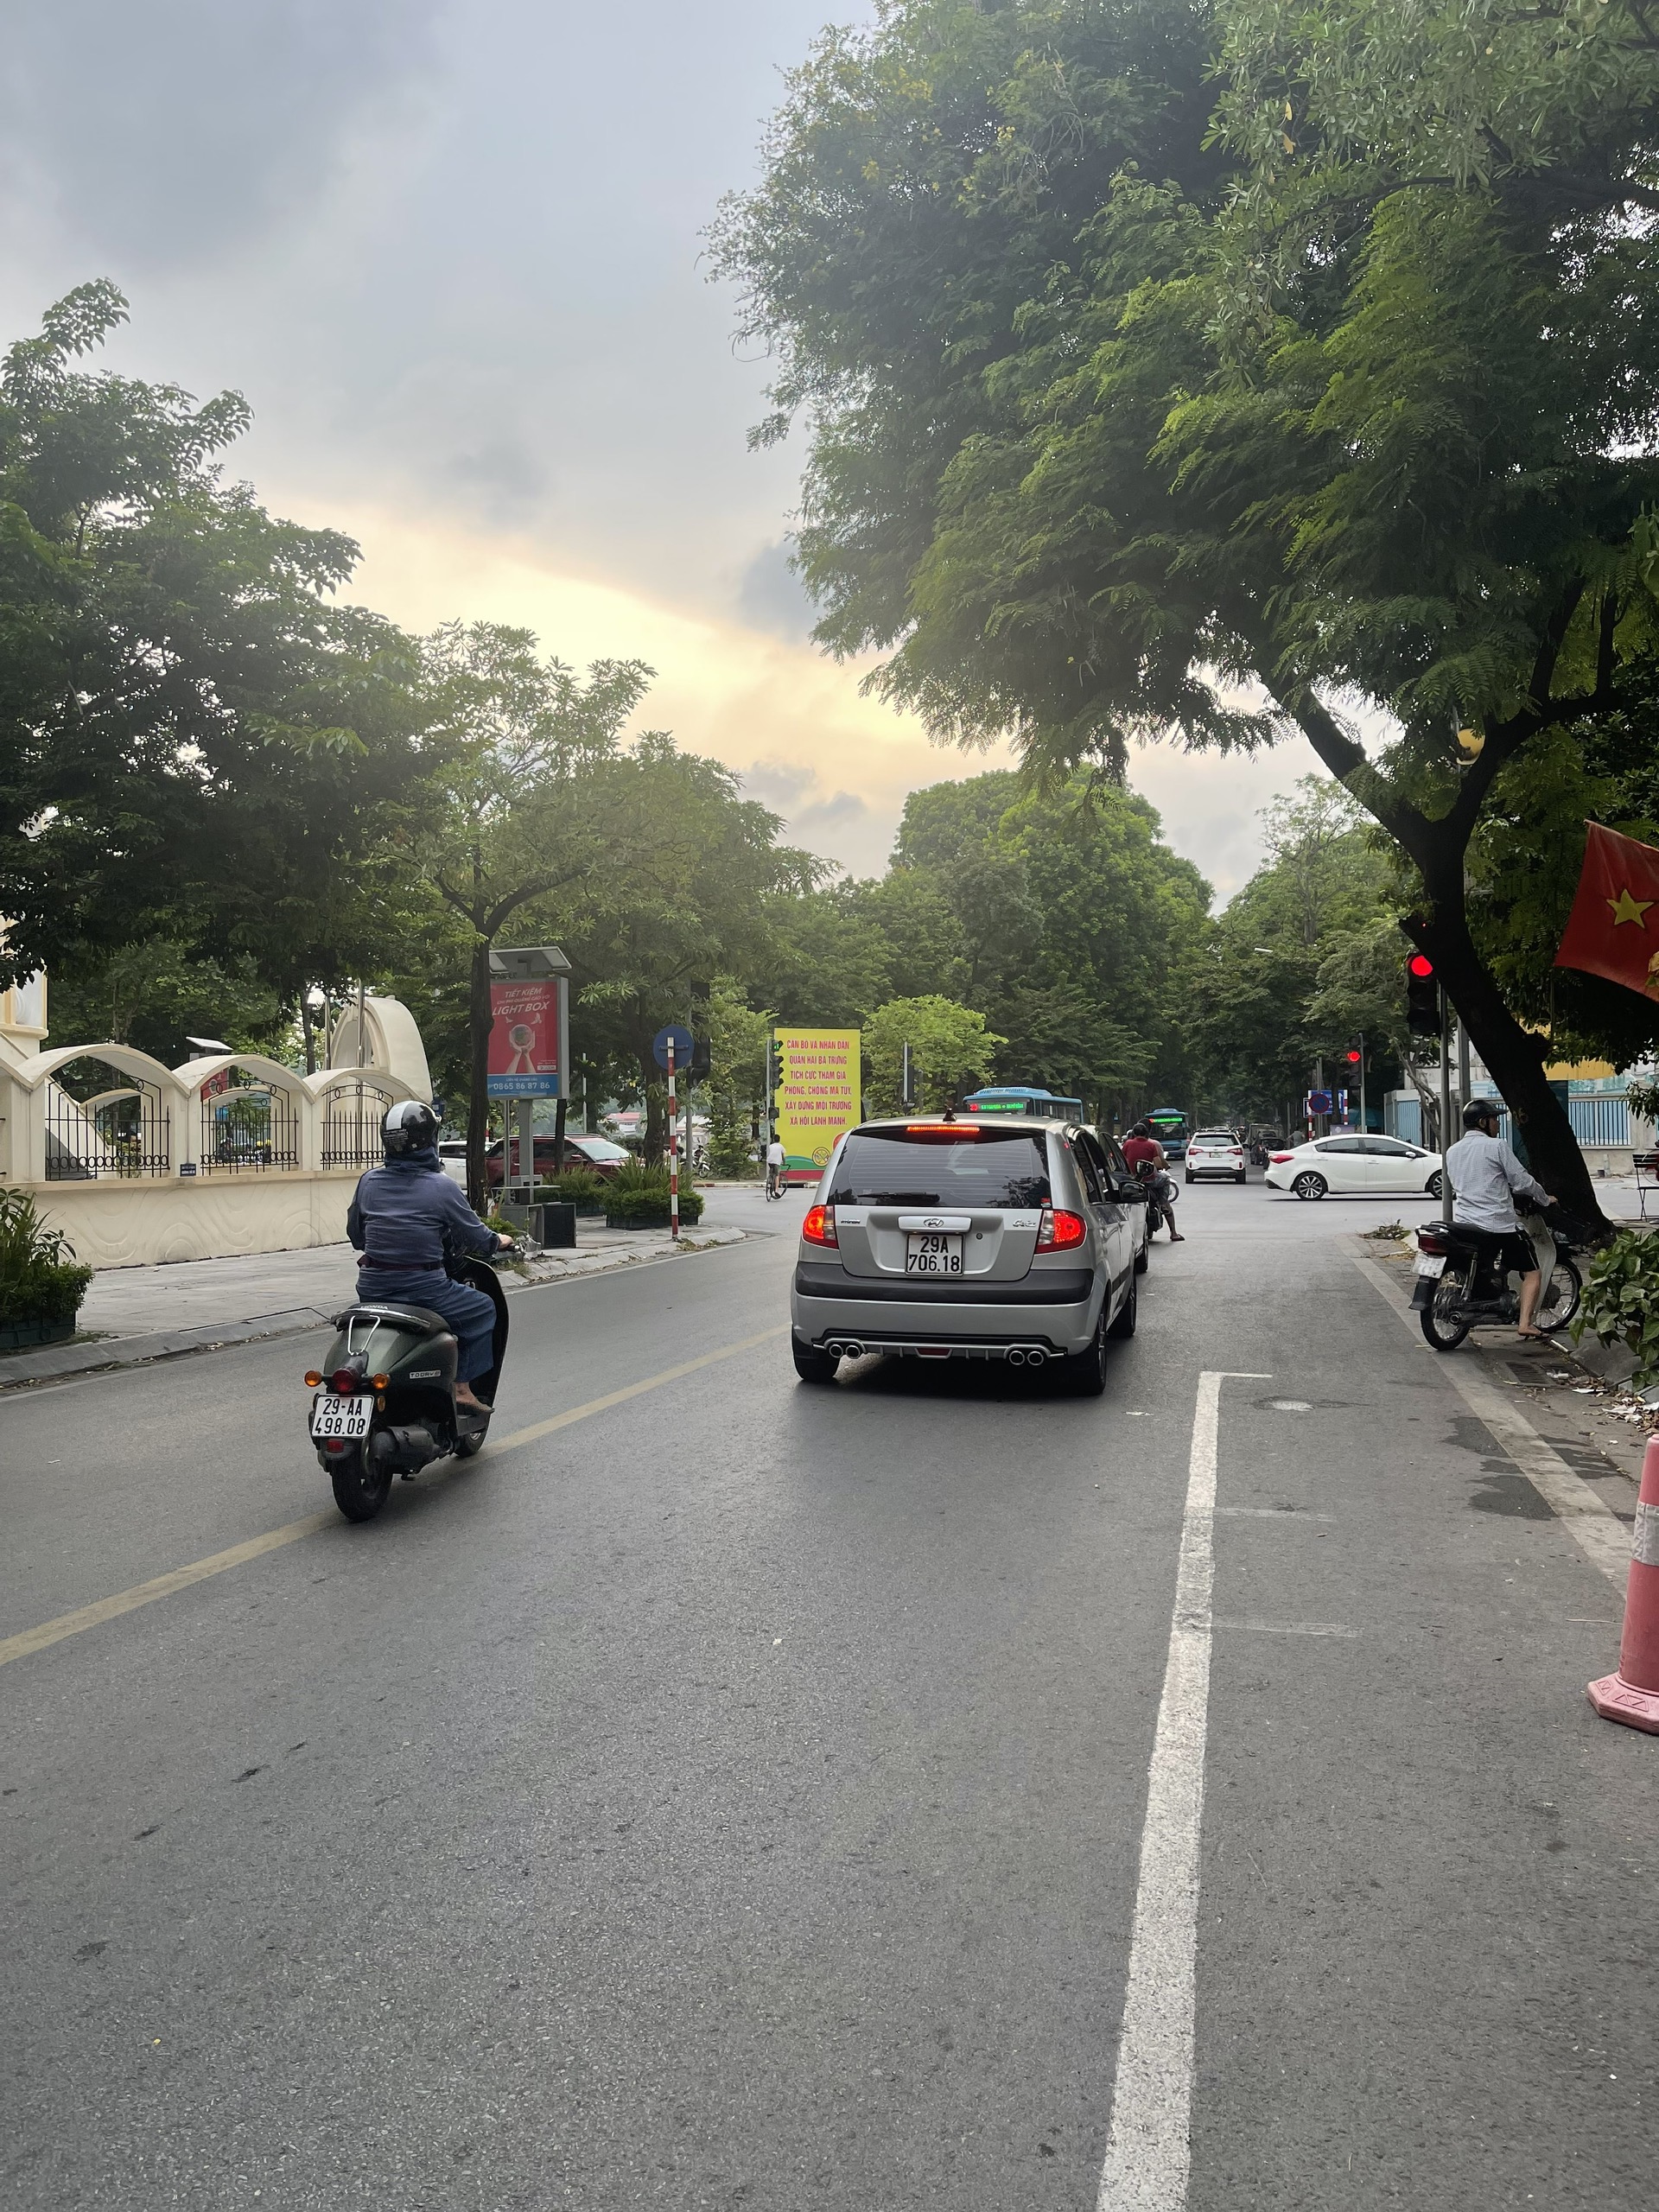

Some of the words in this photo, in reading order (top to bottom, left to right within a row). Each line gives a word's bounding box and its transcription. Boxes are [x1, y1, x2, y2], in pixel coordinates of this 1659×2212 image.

[492, 1004, 524, 1016] LIGHT
[524, 1001, 550, 1012] BOX
[807, 1055, 817, 1065] HAI
[818, 1071, 835, 1080] THAM
[836, 1071, 846, 1080] GIA
[493, 1082, 514, 1090] 0865
[830, 1085, 839, 1095] MA
[920, 1236, 949, 1254] 29A
[909, 1255, 960, 1273] 706.18
[322, 1398, 362, 1416] 29-AA
[315, 1417, 365, 1435] 498.08
